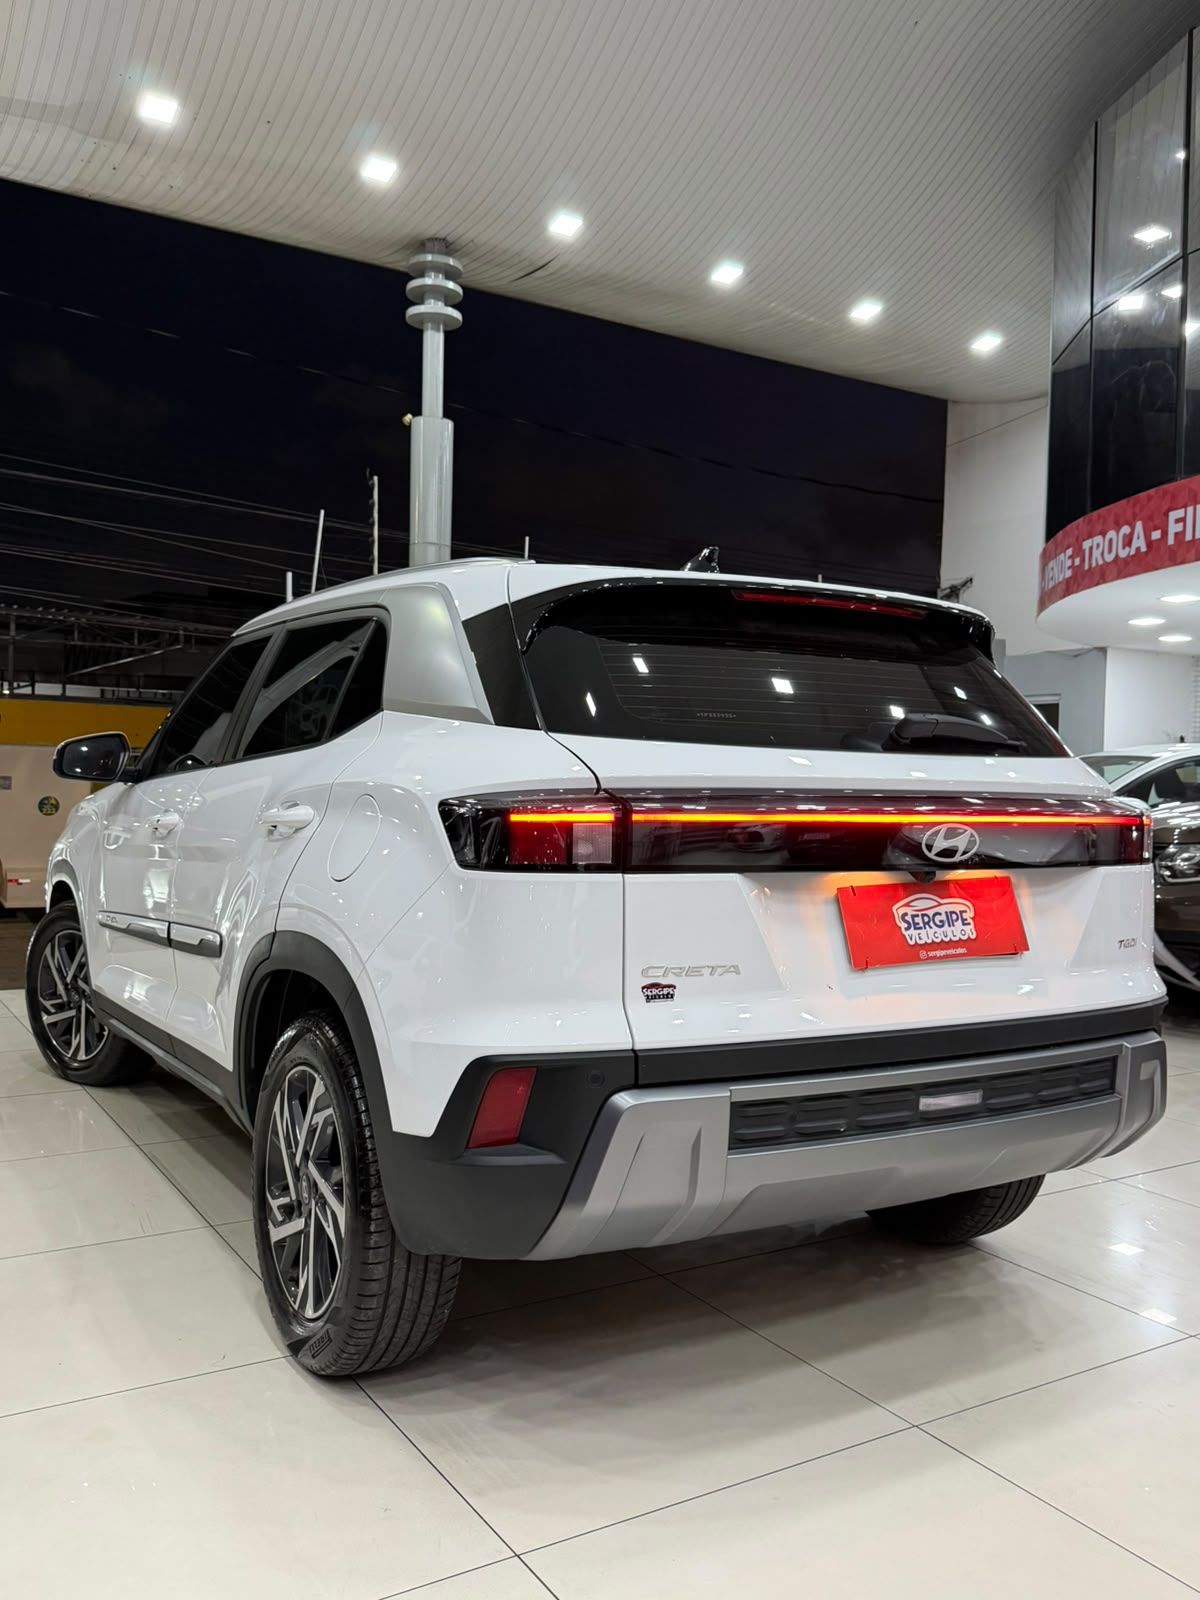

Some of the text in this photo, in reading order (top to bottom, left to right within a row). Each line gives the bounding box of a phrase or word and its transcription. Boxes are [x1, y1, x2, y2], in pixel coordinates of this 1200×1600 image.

[1082, 520, 1148, 571] TROCA
[900, 910, 971, 932] SERGIPE
[641, 964, 741, 978] CRETA
